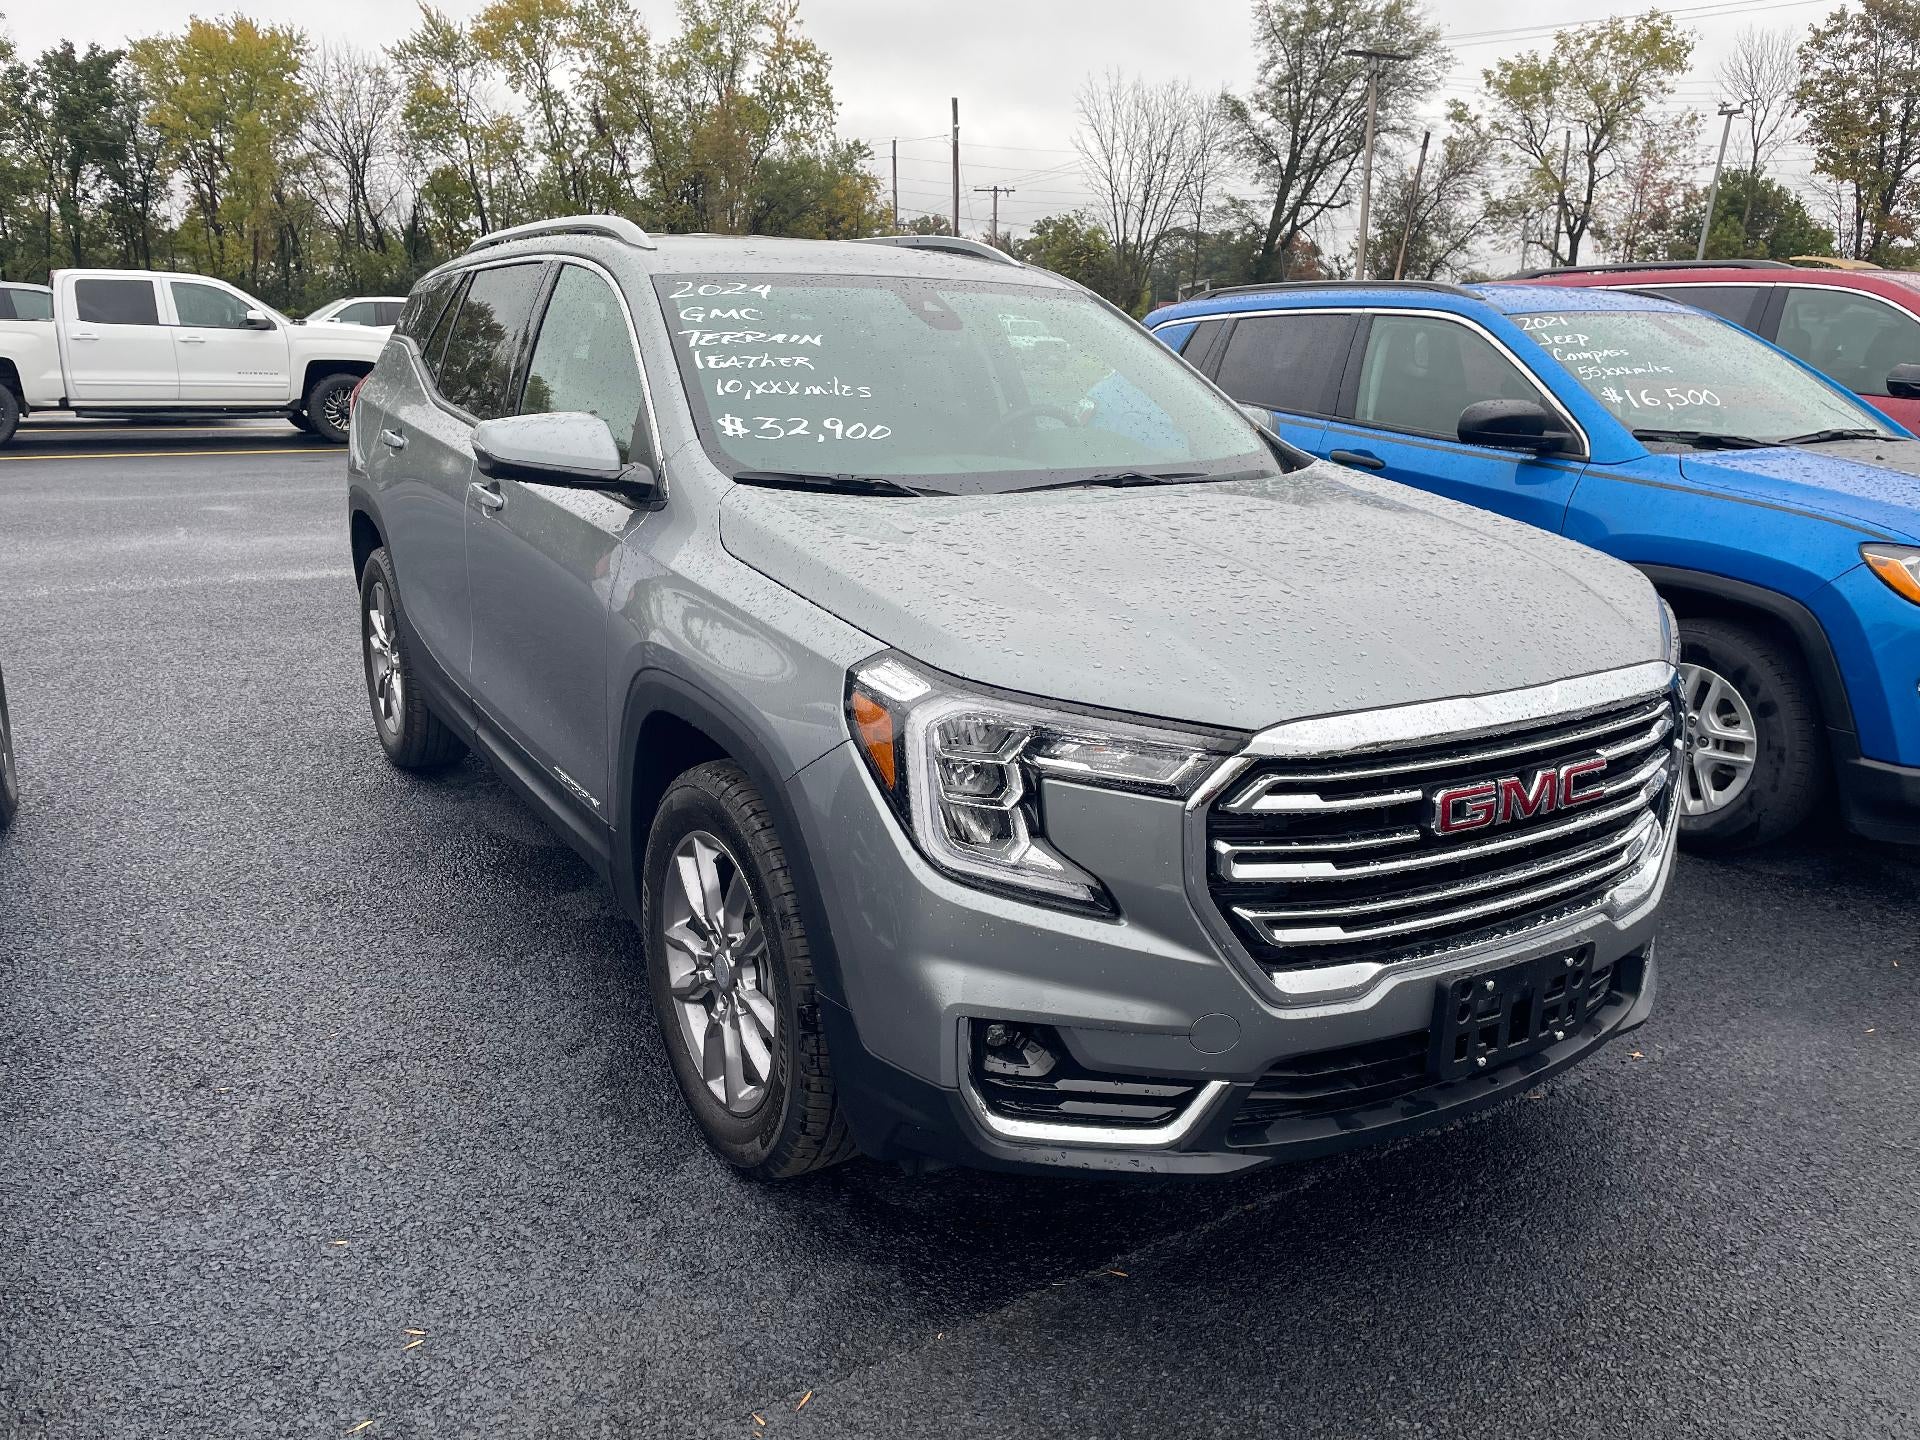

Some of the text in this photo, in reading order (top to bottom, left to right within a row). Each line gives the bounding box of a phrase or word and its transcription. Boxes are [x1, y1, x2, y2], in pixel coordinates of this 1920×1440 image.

[669, 281, 772, 299] 2024
[679, 306, 759, 322] GMC
[1517, 315, 1568, 331] 2021
[677, 329, 824, 347] TERRAIN
[1601, 386, 1722, 410] $16,500
[717, 413, 892, 443] $32,900
[1431, 757, 1608, 836] GMC
